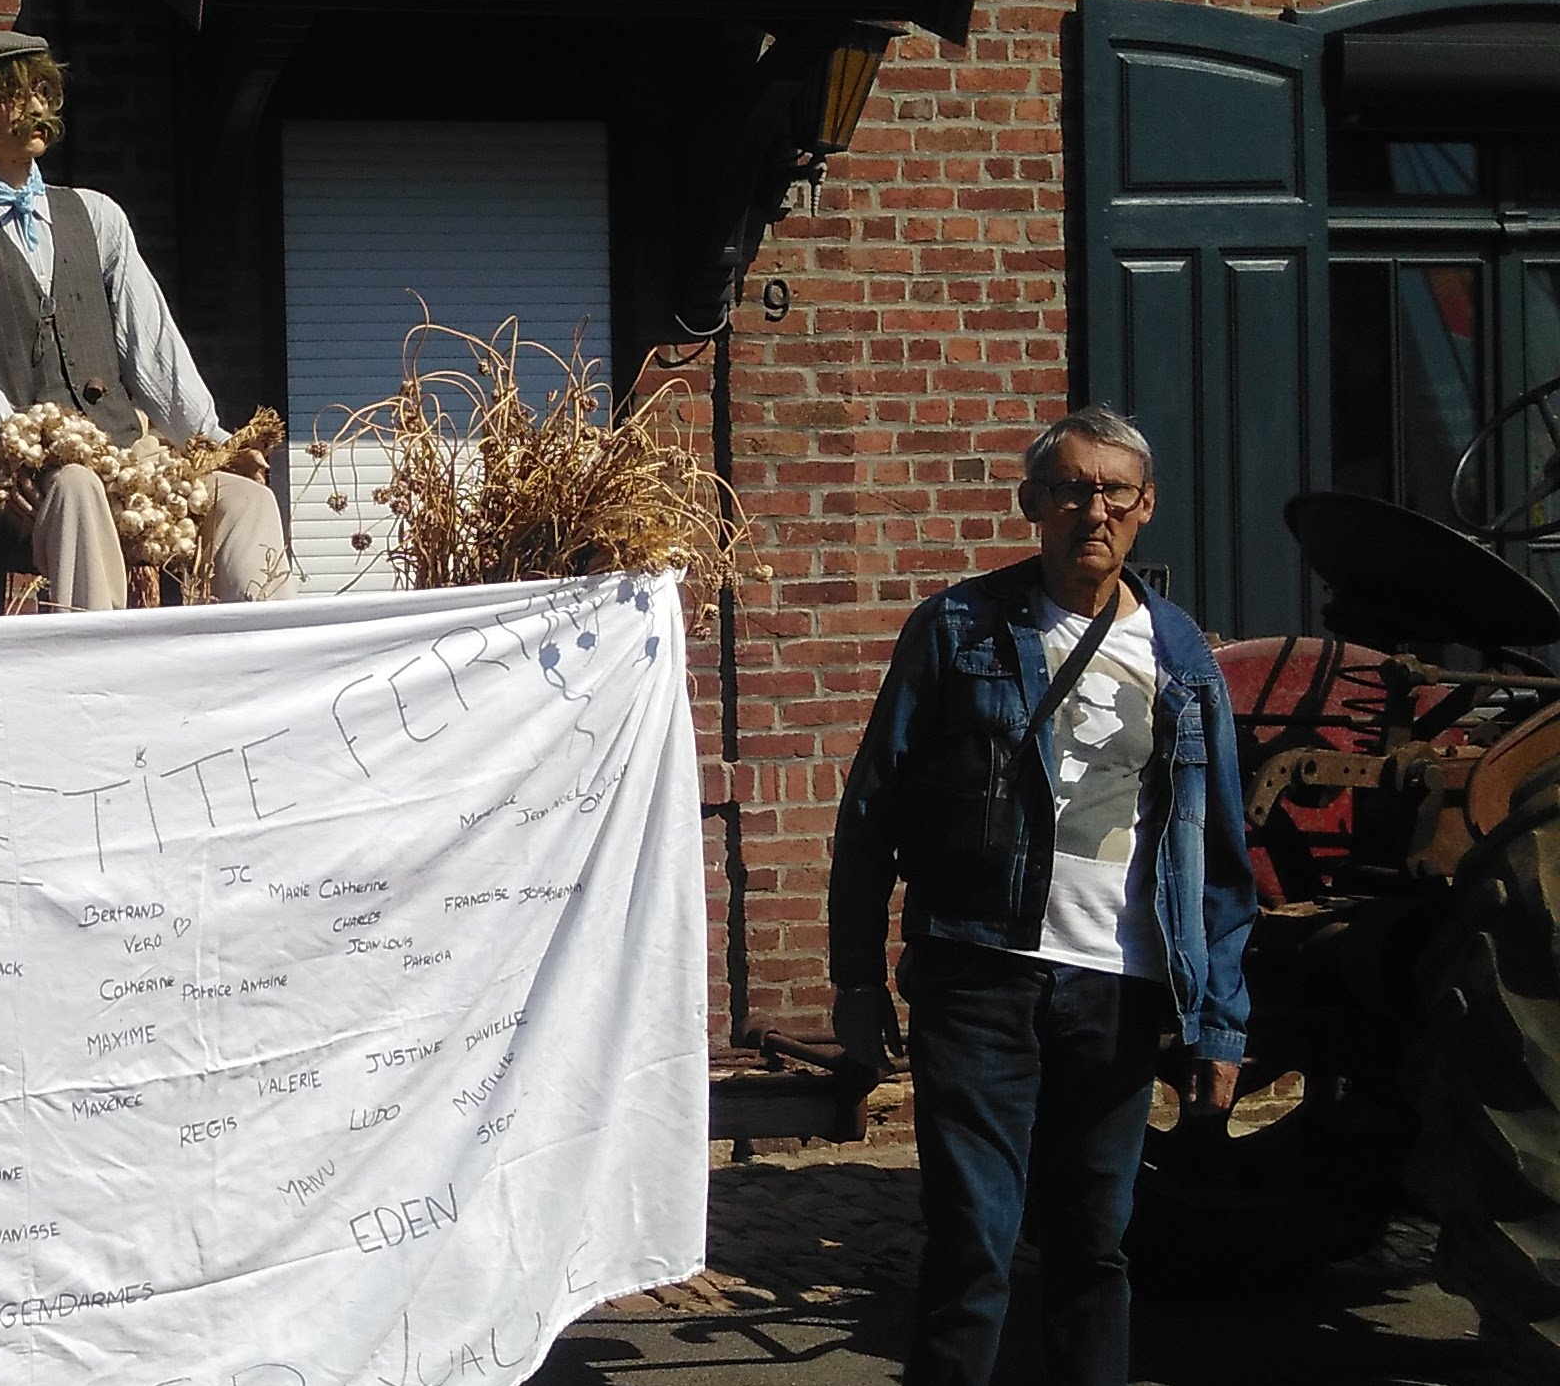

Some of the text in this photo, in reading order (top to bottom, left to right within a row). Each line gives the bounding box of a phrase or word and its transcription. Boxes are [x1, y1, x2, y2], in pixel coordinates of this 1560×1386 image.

[763, 279, 789, 322] 9
[220, 865, 253, 887] JC
[332, 911, 382, 933] CHARLES
[124, 935, 162, 955] VERO
[345, 935, 414, 956] JEAN LOUIS
[86, 1023, 157, 1057] MAXIME
[365, 1040, 443, 1074] JUSTINE
[257, 1070, 323, 1098] VALERIE
[71, 1093, 144, 1122] MAXENCE
[349, 1103, 402, 1132] LUDO
[179, 1115, 239, 1148] REGIS
[349, 1182, 461, 1254] EDEN
